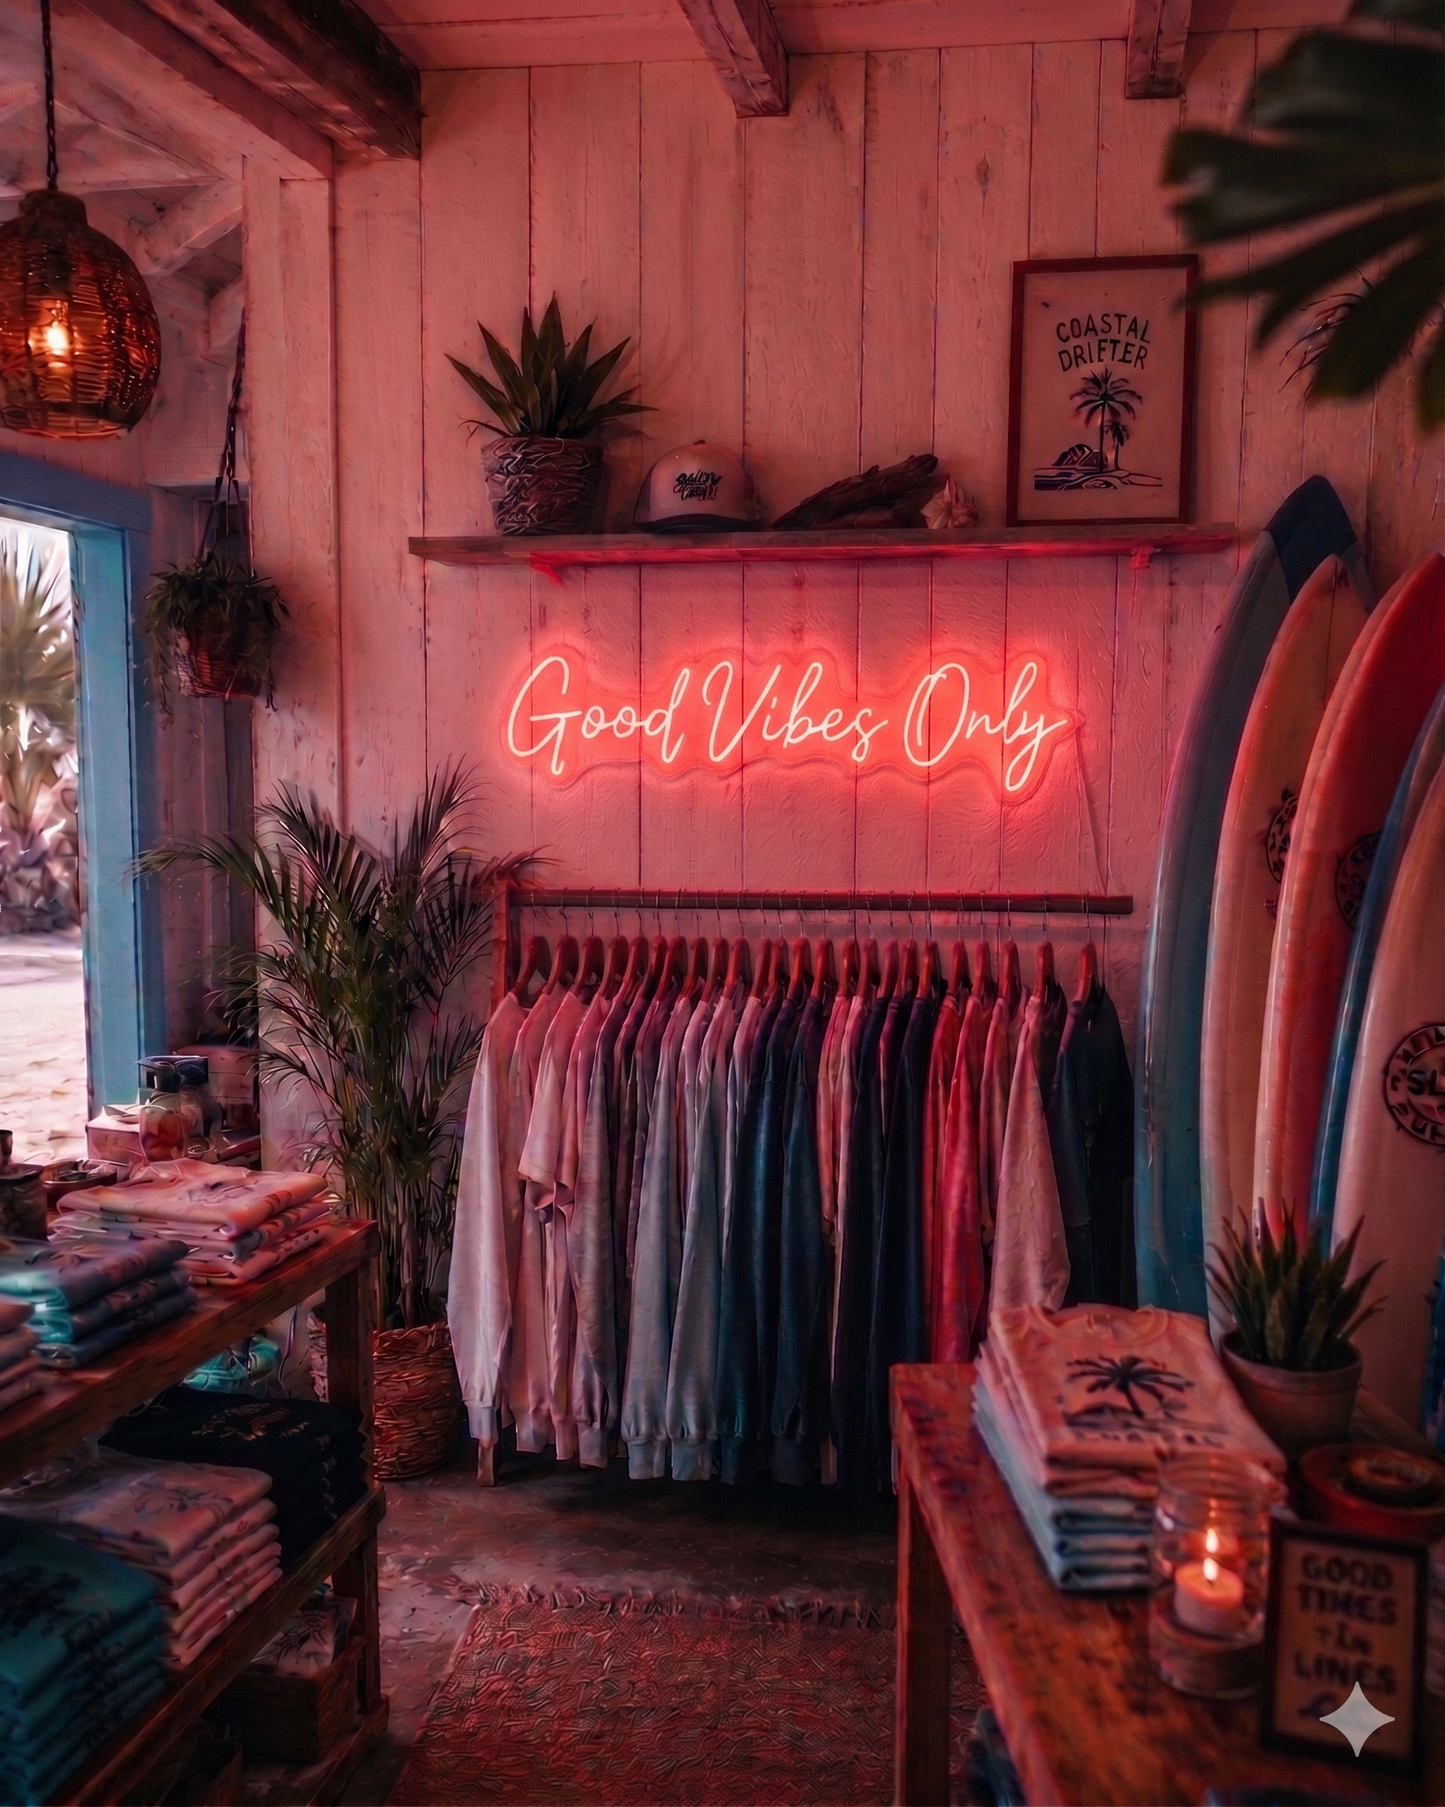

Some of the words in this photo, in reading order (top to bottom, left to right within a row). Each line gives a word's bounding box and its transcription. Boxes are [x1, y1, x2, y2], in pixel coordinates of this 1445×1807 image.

[1056, 313, 1150, 343] COASTAL
[508, 655, 690, 776] Good
[702, 660, 888, 763] Vibes
[903, 661, 1068, 792] Only
[1300, 1552, 1394, 1590] GOOD
